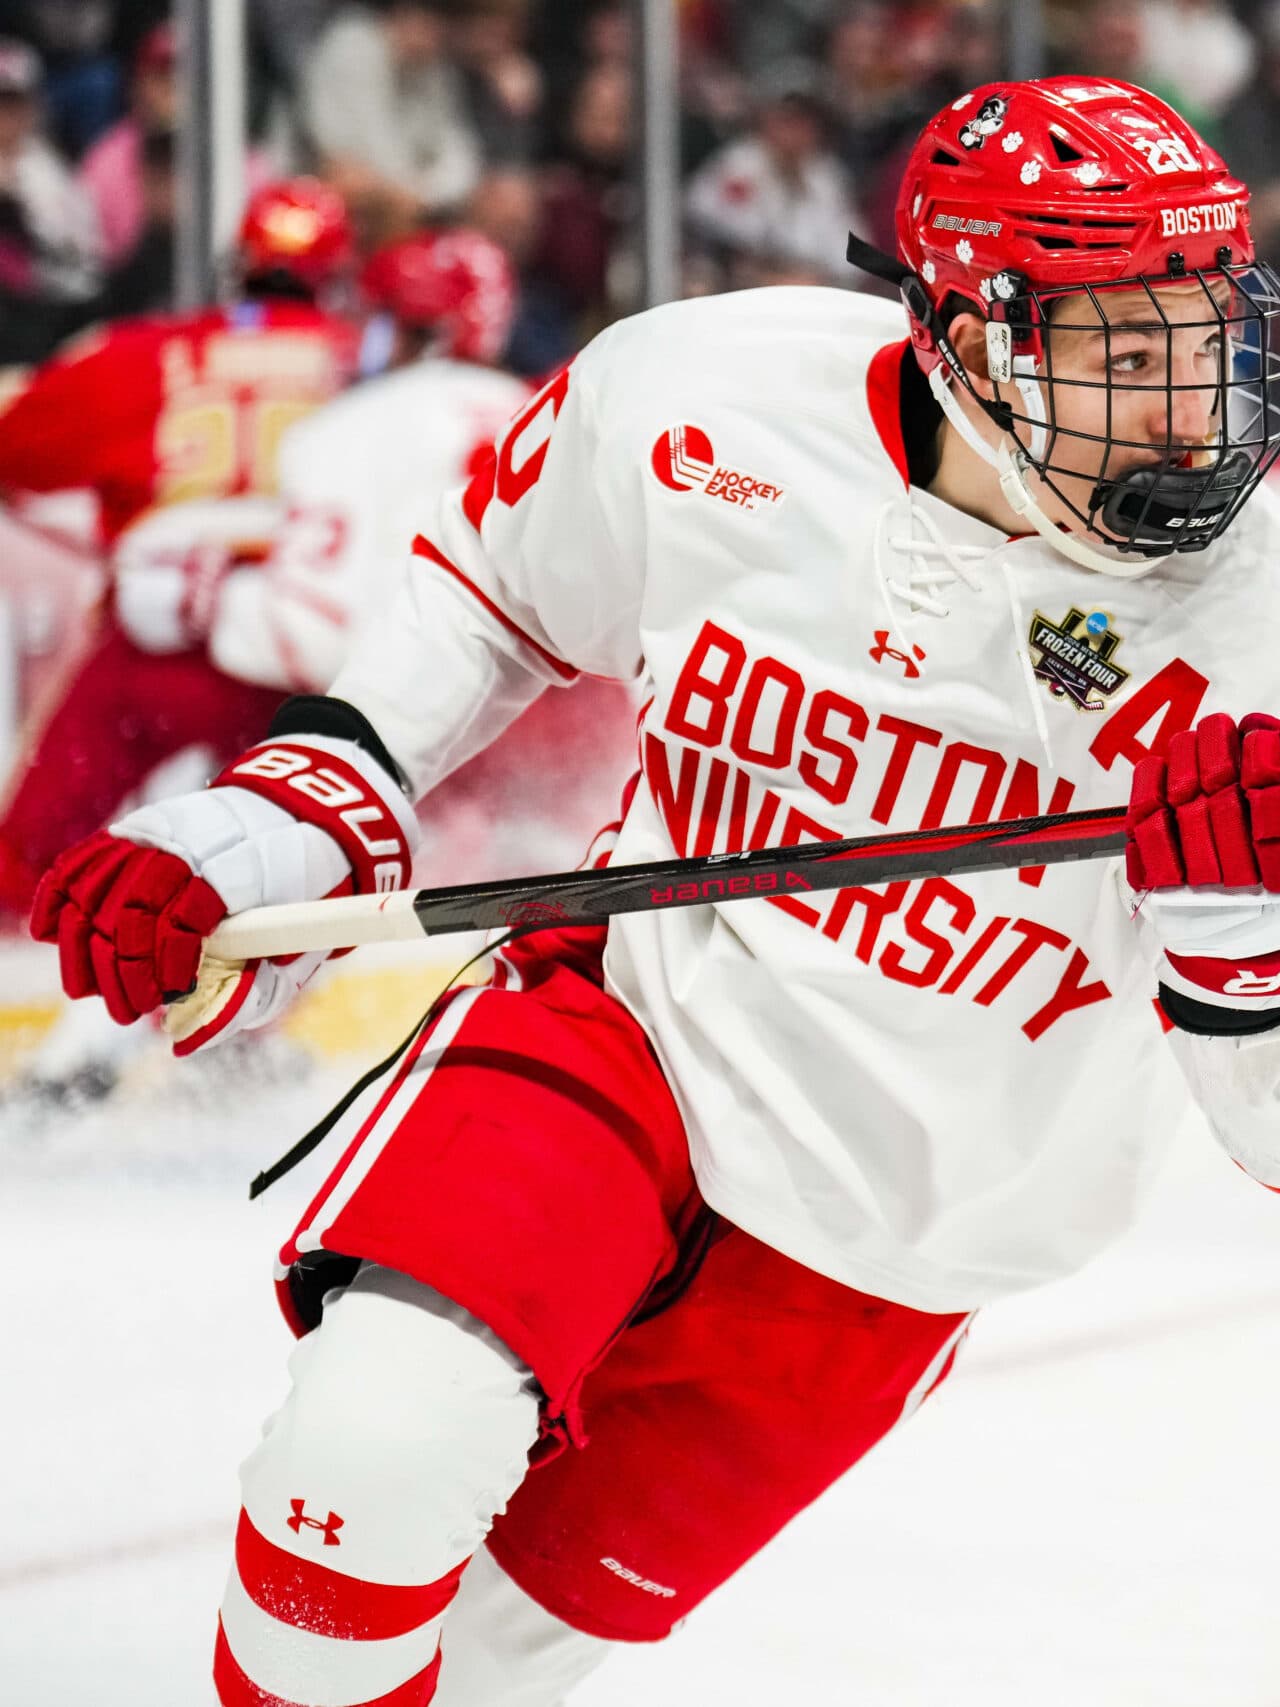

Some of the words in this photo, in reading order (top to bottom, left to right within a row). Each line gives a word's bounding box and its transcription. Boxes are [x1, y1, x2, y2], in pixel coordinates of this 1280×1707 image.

[1133, 136, 1202, 175] 20
[932, 213, 1002, 238] BAUER
[1160, 202, 1237, 237] BOSTON
[704, 481, 752, 505] EAST
[712, 467, 783, 502] HOCKEY
[1035, 627, 1086, 668] FROZEN
[1081, 659, 1118, 689] FOUR
[1088, 657, 1210, 772] A
[664, 619, 1077, 888] BOSTON
[232, 748, 402, 894] BAUE
[642, 730, 1113, 1042] NIVERSITY
[651, 870, 778, 905] BAUER
[600, 1557, 677, 1598] BAUER
